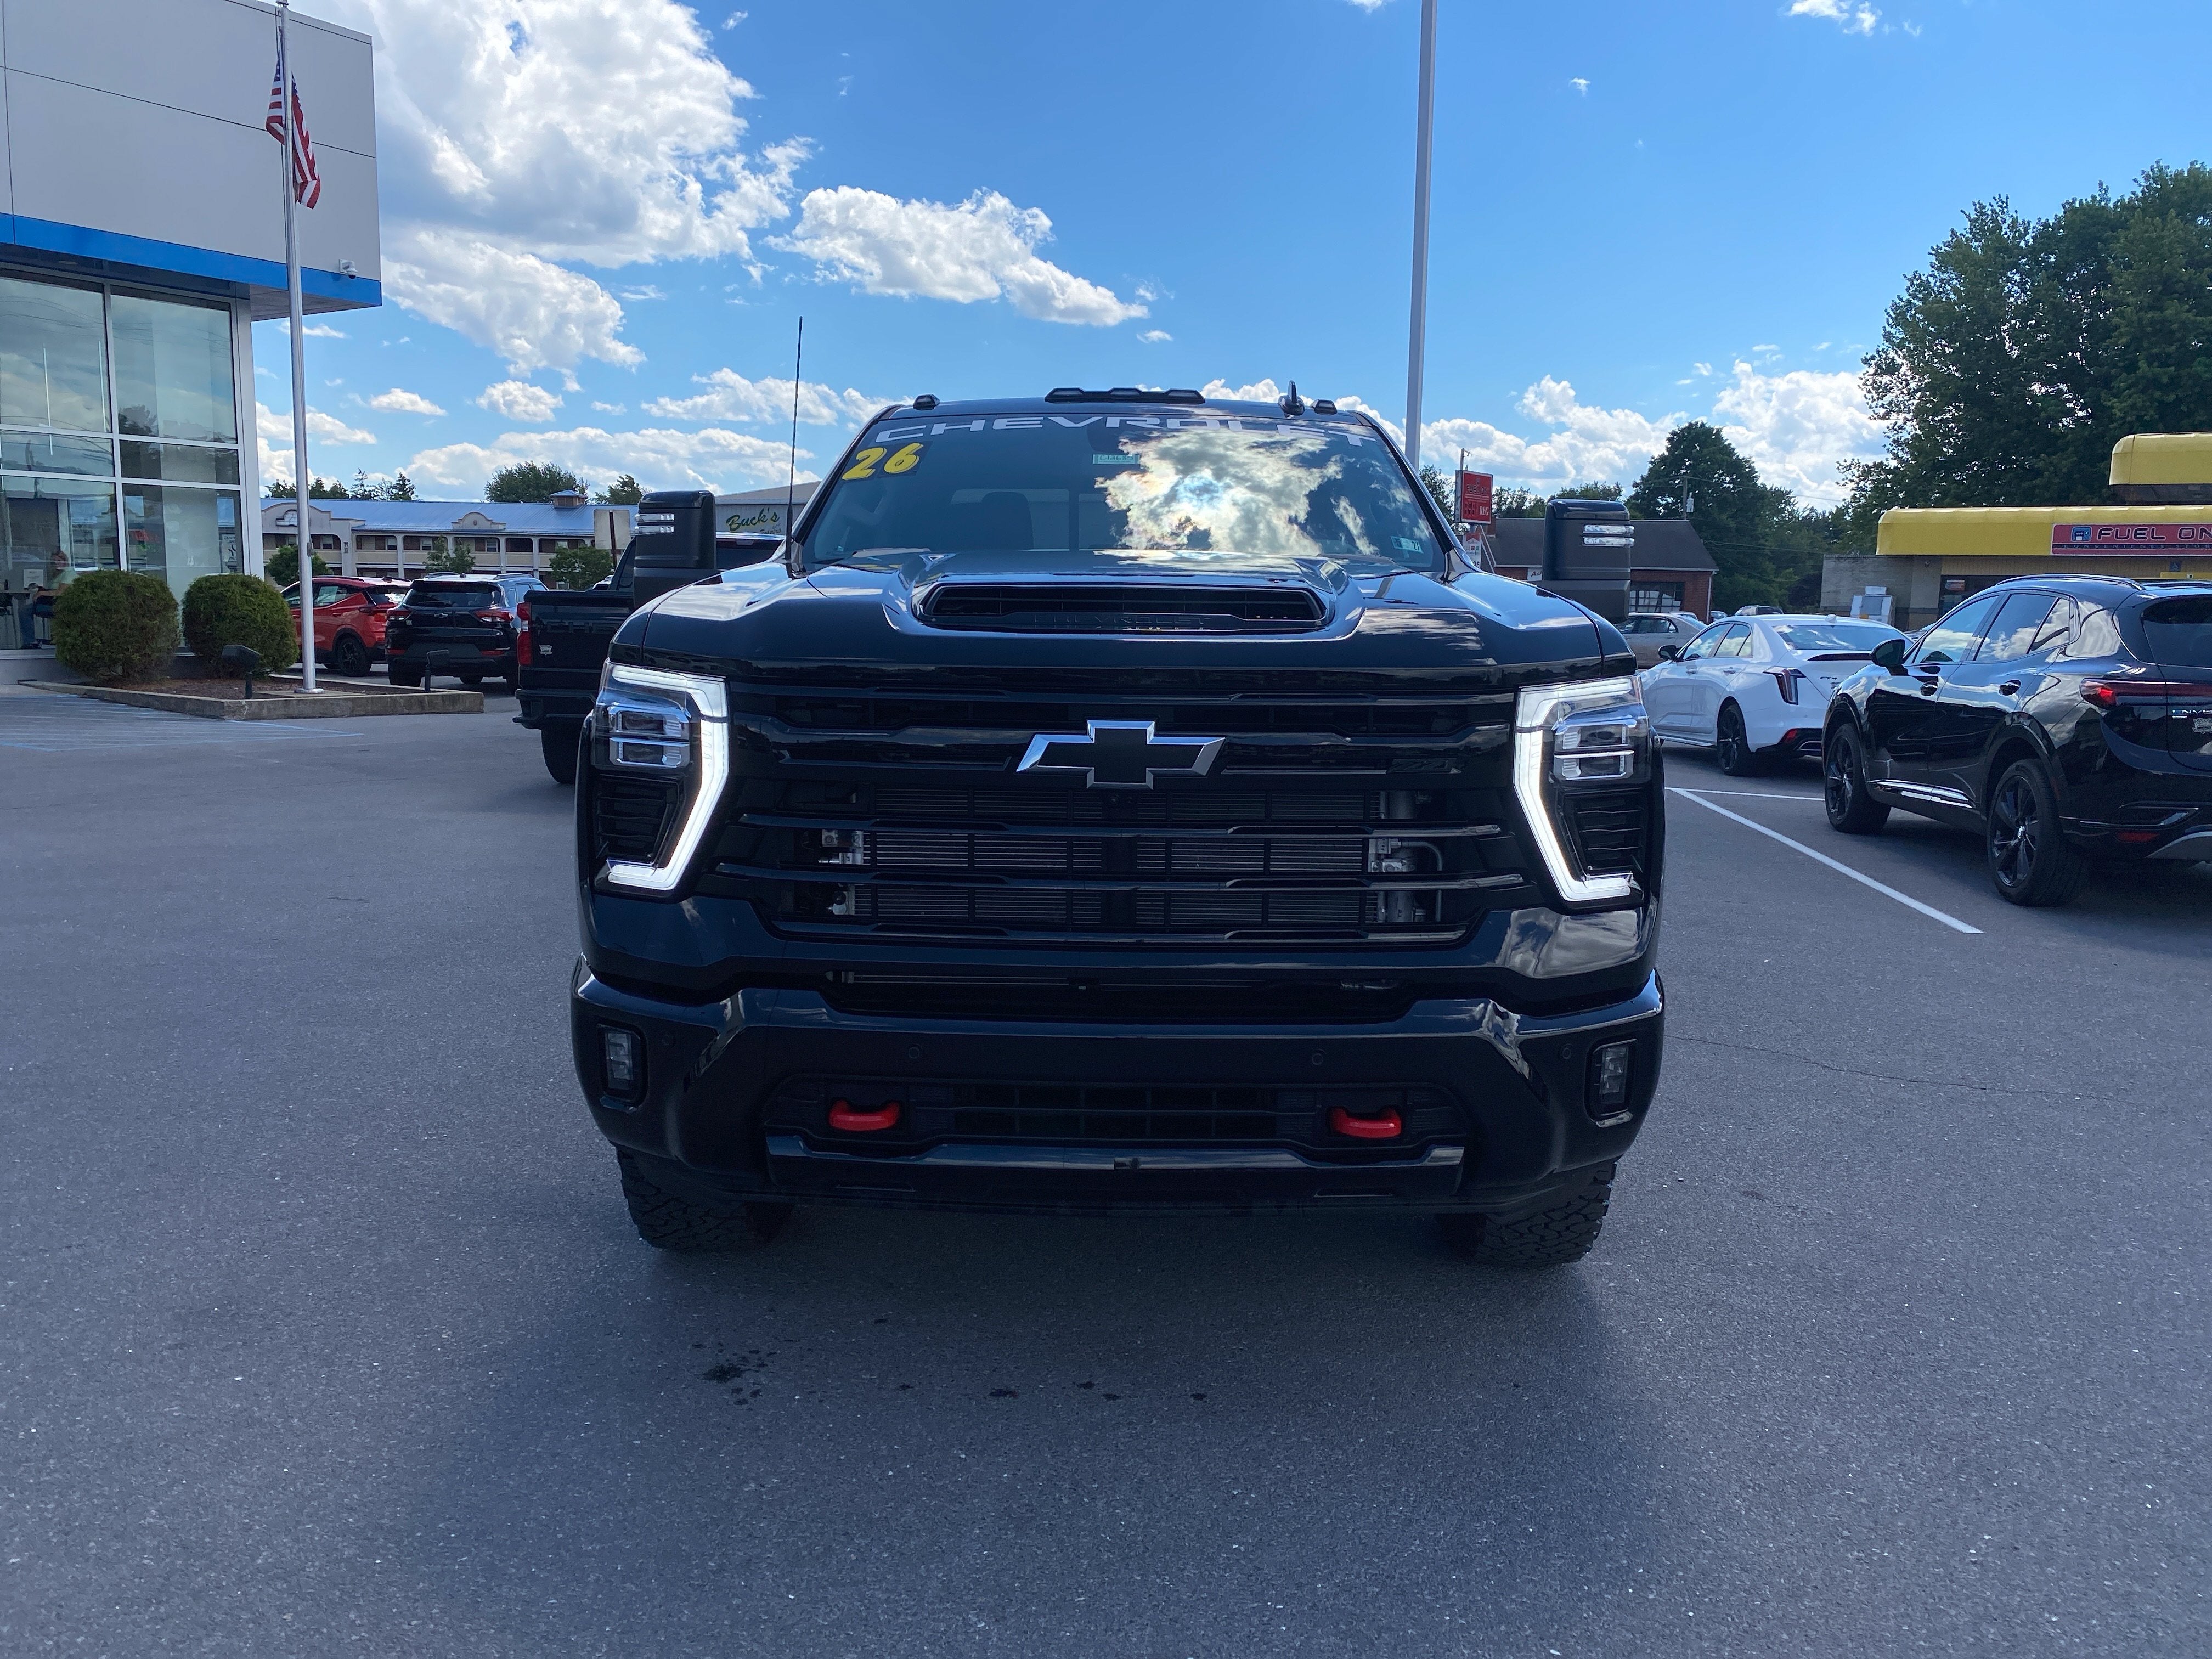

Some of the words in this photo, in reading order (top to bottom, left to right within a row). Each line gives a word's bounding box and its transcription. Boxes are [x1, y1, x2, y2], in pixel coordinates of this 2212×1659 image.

[875, 416, 1376, 447] CHEVROLET
[842, 443, 924, 481] 26
[726, 507, 780, 531] Buck's
[1479, 506, 1489, 516] REG
[2097, 527, 2166, 540] FUEL
